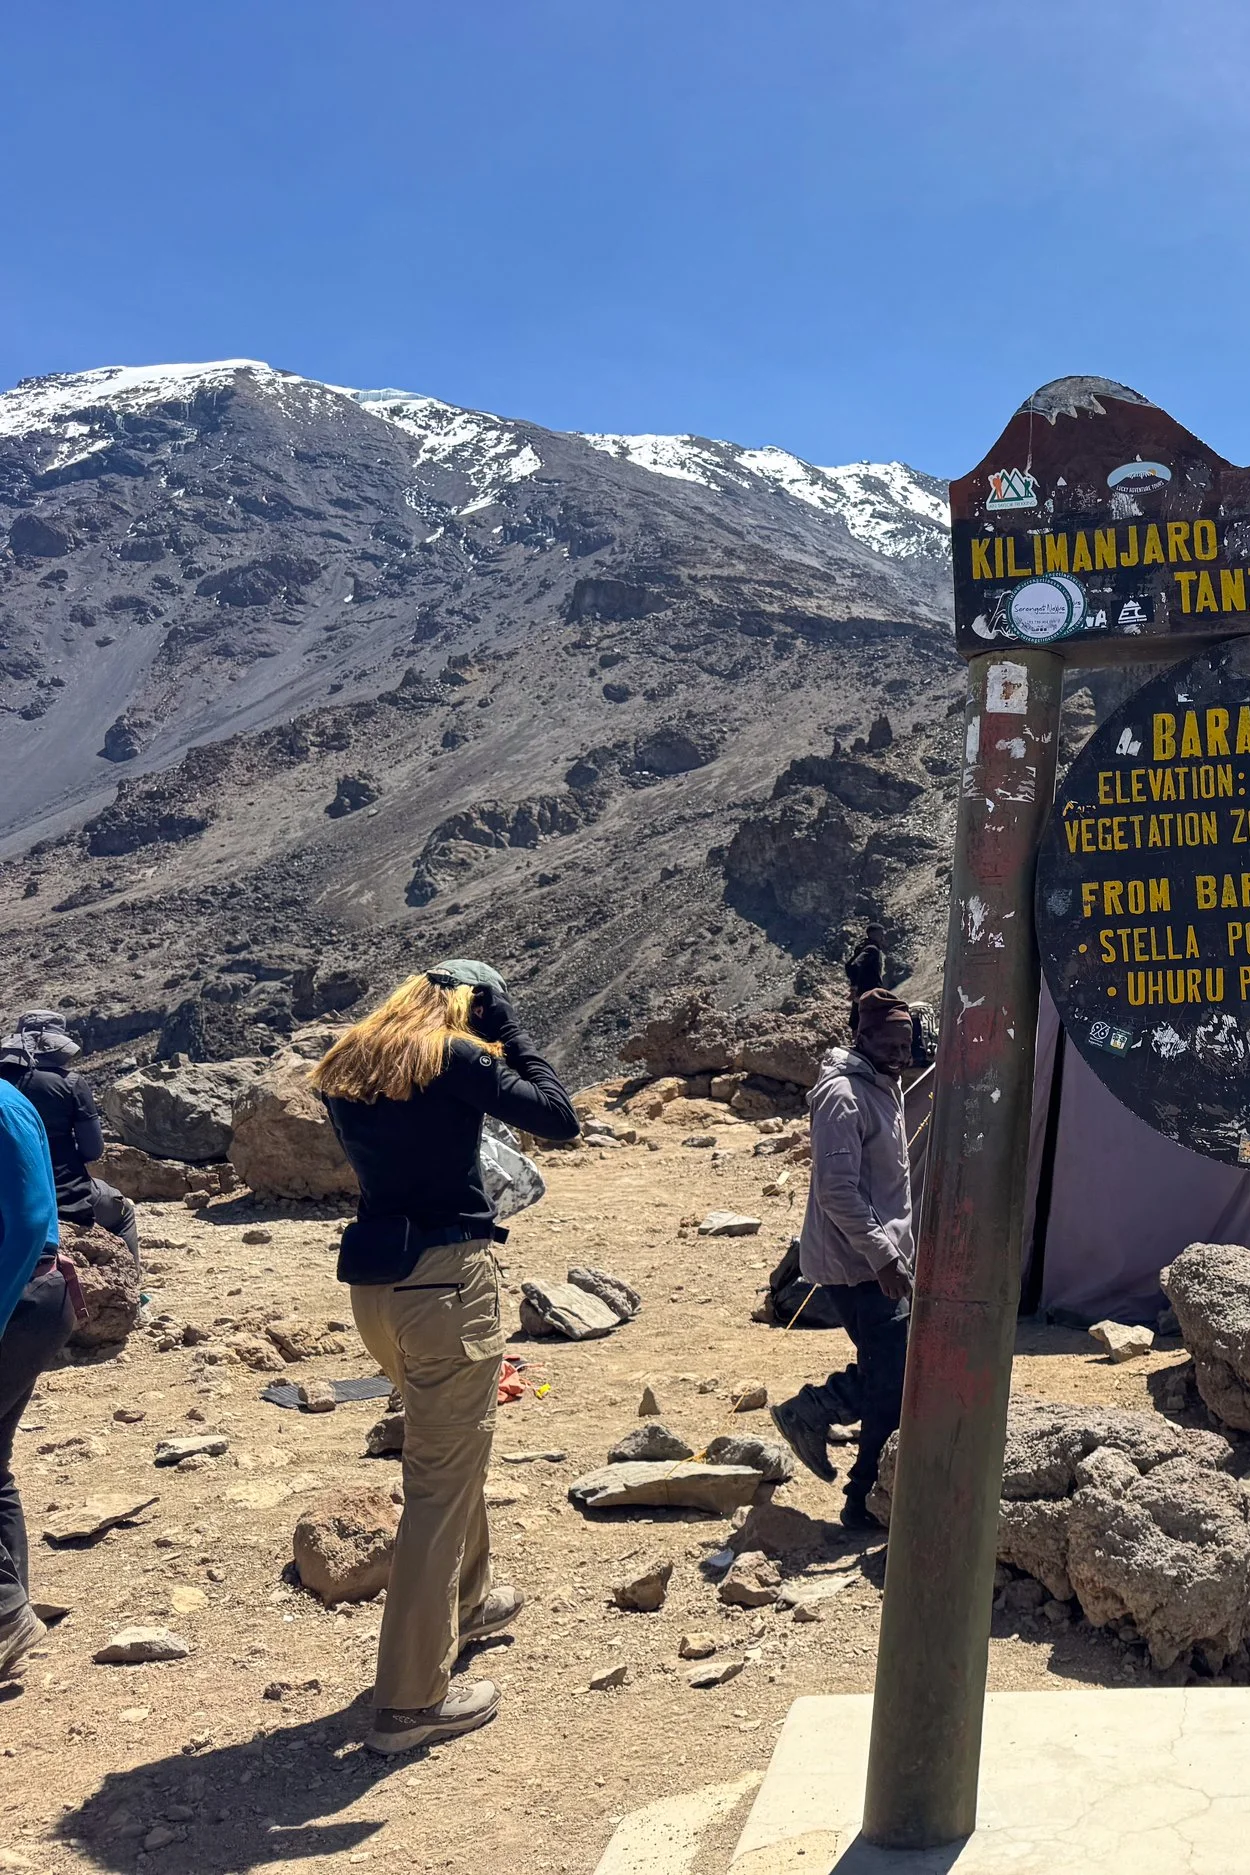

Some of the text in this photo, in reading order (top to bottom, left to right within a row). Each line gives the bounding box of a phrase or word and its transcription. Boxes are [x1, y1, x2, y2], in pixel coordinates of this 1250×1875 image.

[1129, 485, 1151, 493] ADVENTURE
[1152, 480, 1165, 489] TOURS
[972, 520, 1217, 579] KILIMANJARO
[1099, 765, 1245, 804] ELEVATION:
[1065, 813, 1217, 853] VEGETATION
[1082, 879, 1170, 917] FROM
[1100, 927, 1199, 963] STELLA
[1128, 968, 1223, 1005] UHURU
